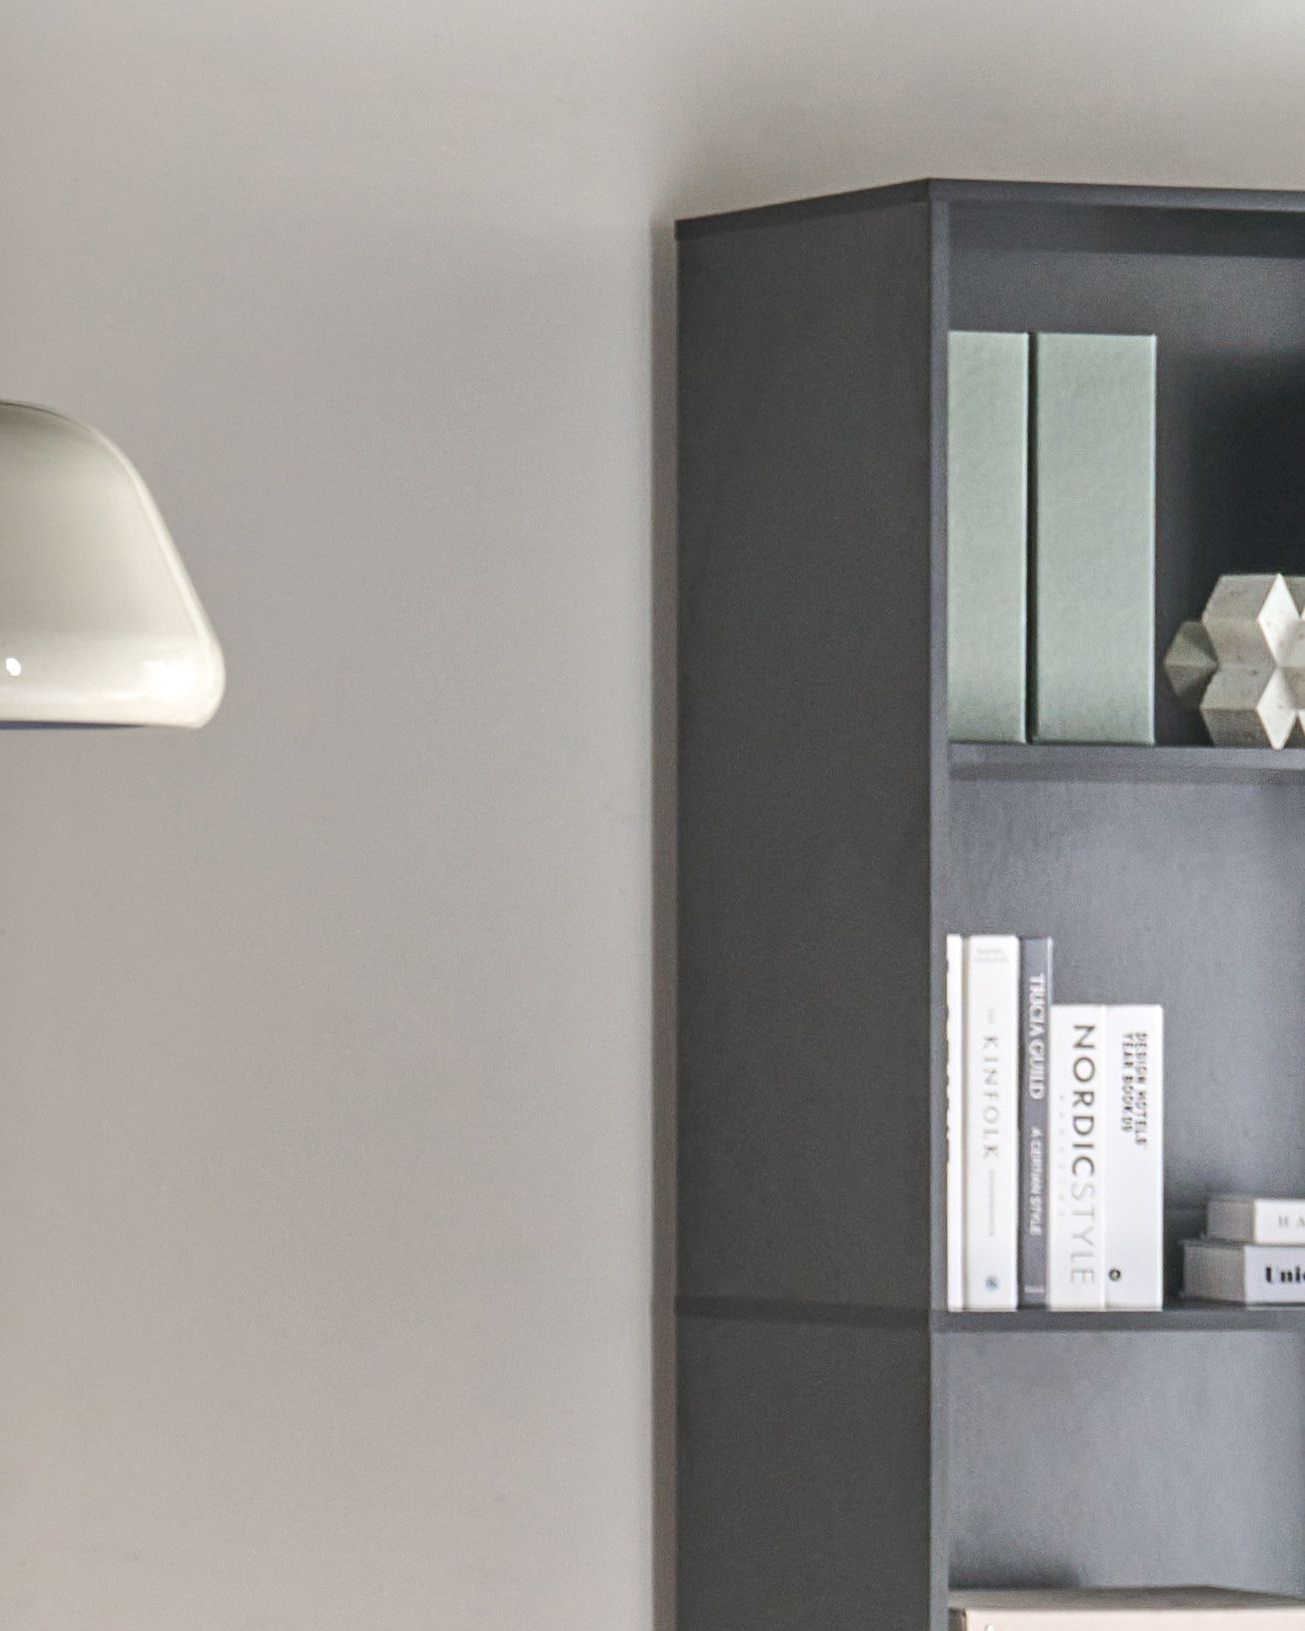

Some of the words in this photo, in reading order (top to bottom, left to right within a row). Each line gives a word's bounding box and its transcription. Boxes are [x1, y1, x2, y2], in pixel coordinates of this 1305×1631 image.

[1029, 1039, 1046, 1100] GUILD
[1122, 1032, 1134, 1069] YEAR
[1135, 1032, 1148, 1085] DESIGN
[982, 1035, 1000, 1160] KINFOLK
